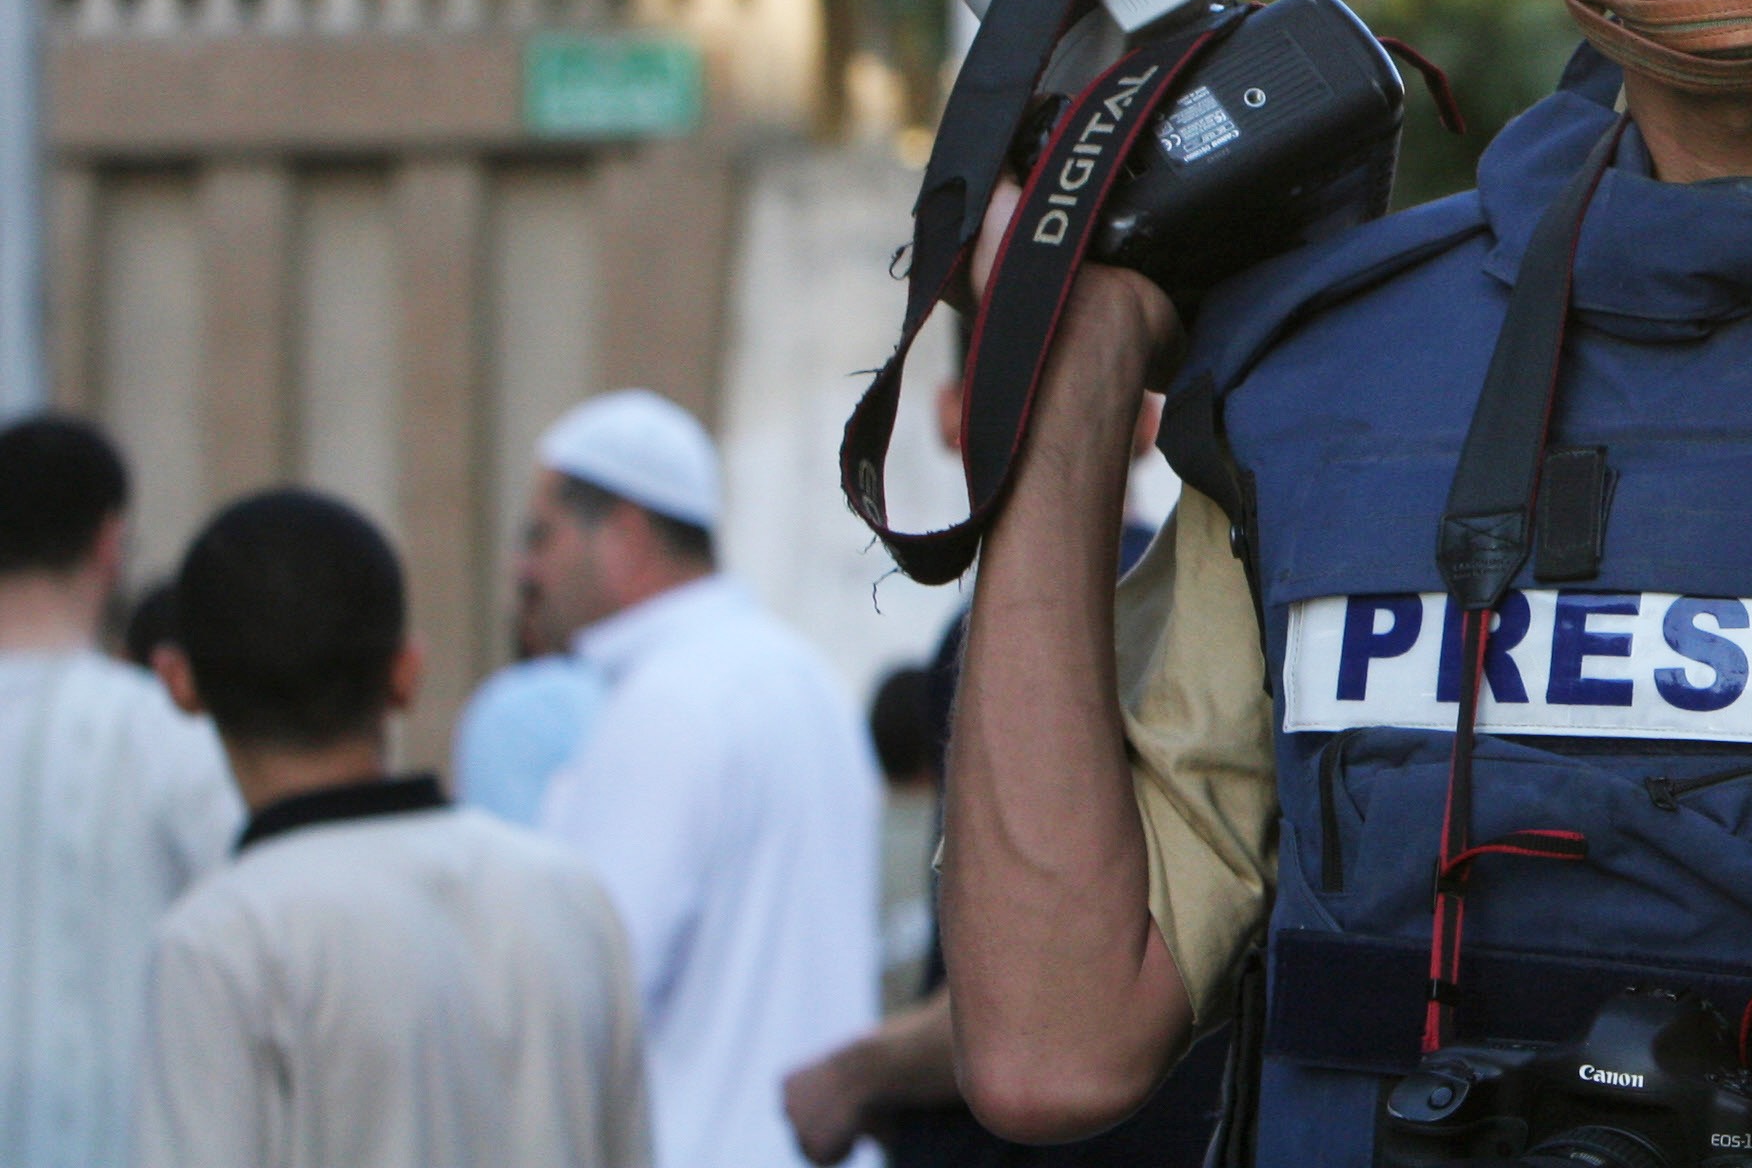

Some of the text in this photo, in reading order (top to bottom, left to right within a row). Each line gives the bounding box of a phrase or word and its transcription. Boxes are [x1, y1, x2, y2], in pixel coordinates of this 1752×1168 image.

[1032, 64, 1160, 247] DIGITAL
[1578, 1064, 1645, 1089] Canon
[1711, 1133, 1752, 1149] EOS-1
